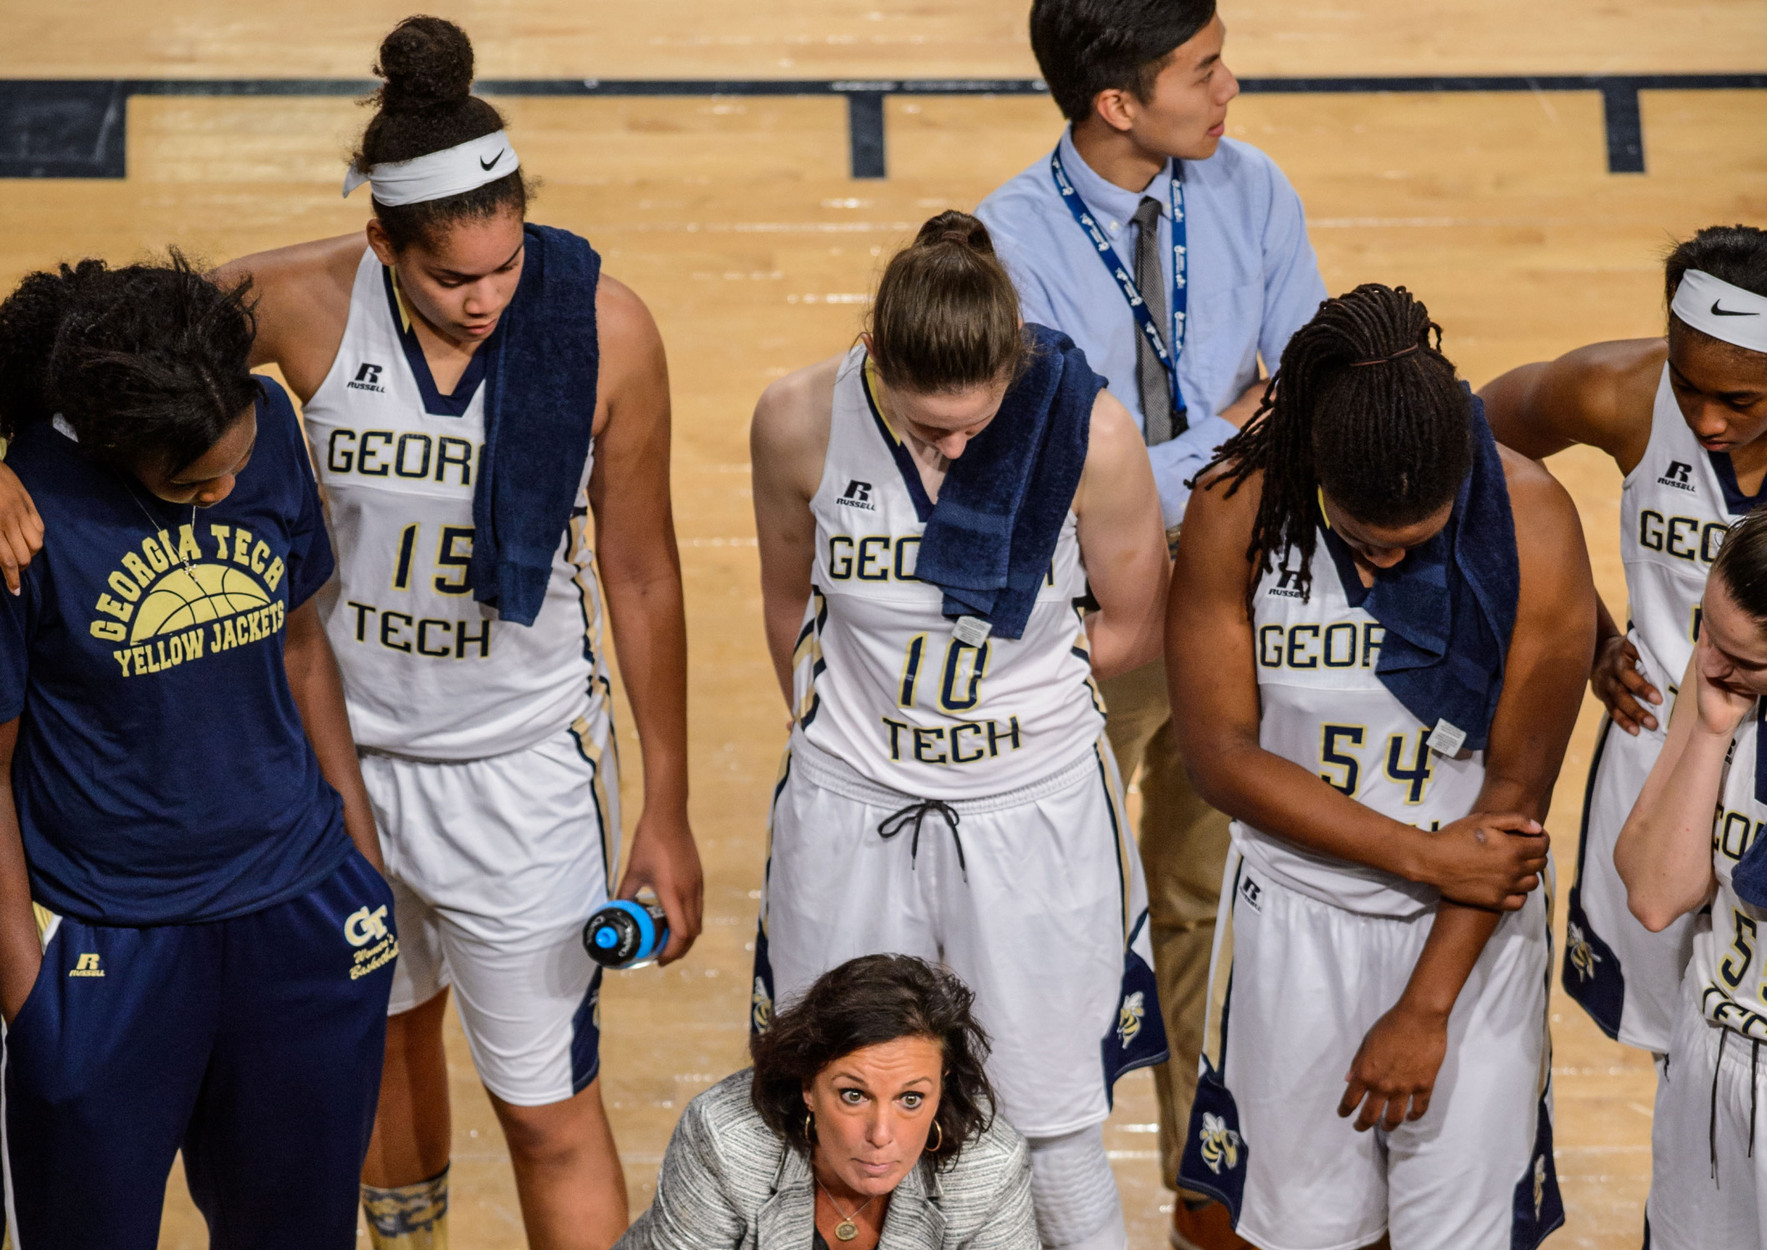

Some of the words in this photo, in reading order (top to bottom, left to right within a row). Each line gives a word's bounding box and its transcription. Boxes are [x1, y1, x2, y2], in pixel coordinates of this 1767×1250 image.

[347, 381, 386, 393] RUSSELL
[327, 427, 486, 487] GEOR
[1657, 477, 1697, 492] RUSSELL
[836, 497, 876, 511] RUSSELL
[90, 523, 202, 642] GEORGIA
[210, 524, 285, 592] TECH
[391, 522, 476, 597] 15
[1268, 588, 1303, 599] RUSSE
[113, 628, 204, 677] YELLOW
[210, 600, 285, 653] JACKETS
[346, 600, 491, 659] TECH
[896, 631, 992, 715] 10
[881, 713, 1022, 765] TECH
[1318, 721, 1436, 806] 54
[69, 969, 105, 977] RUSSELL
